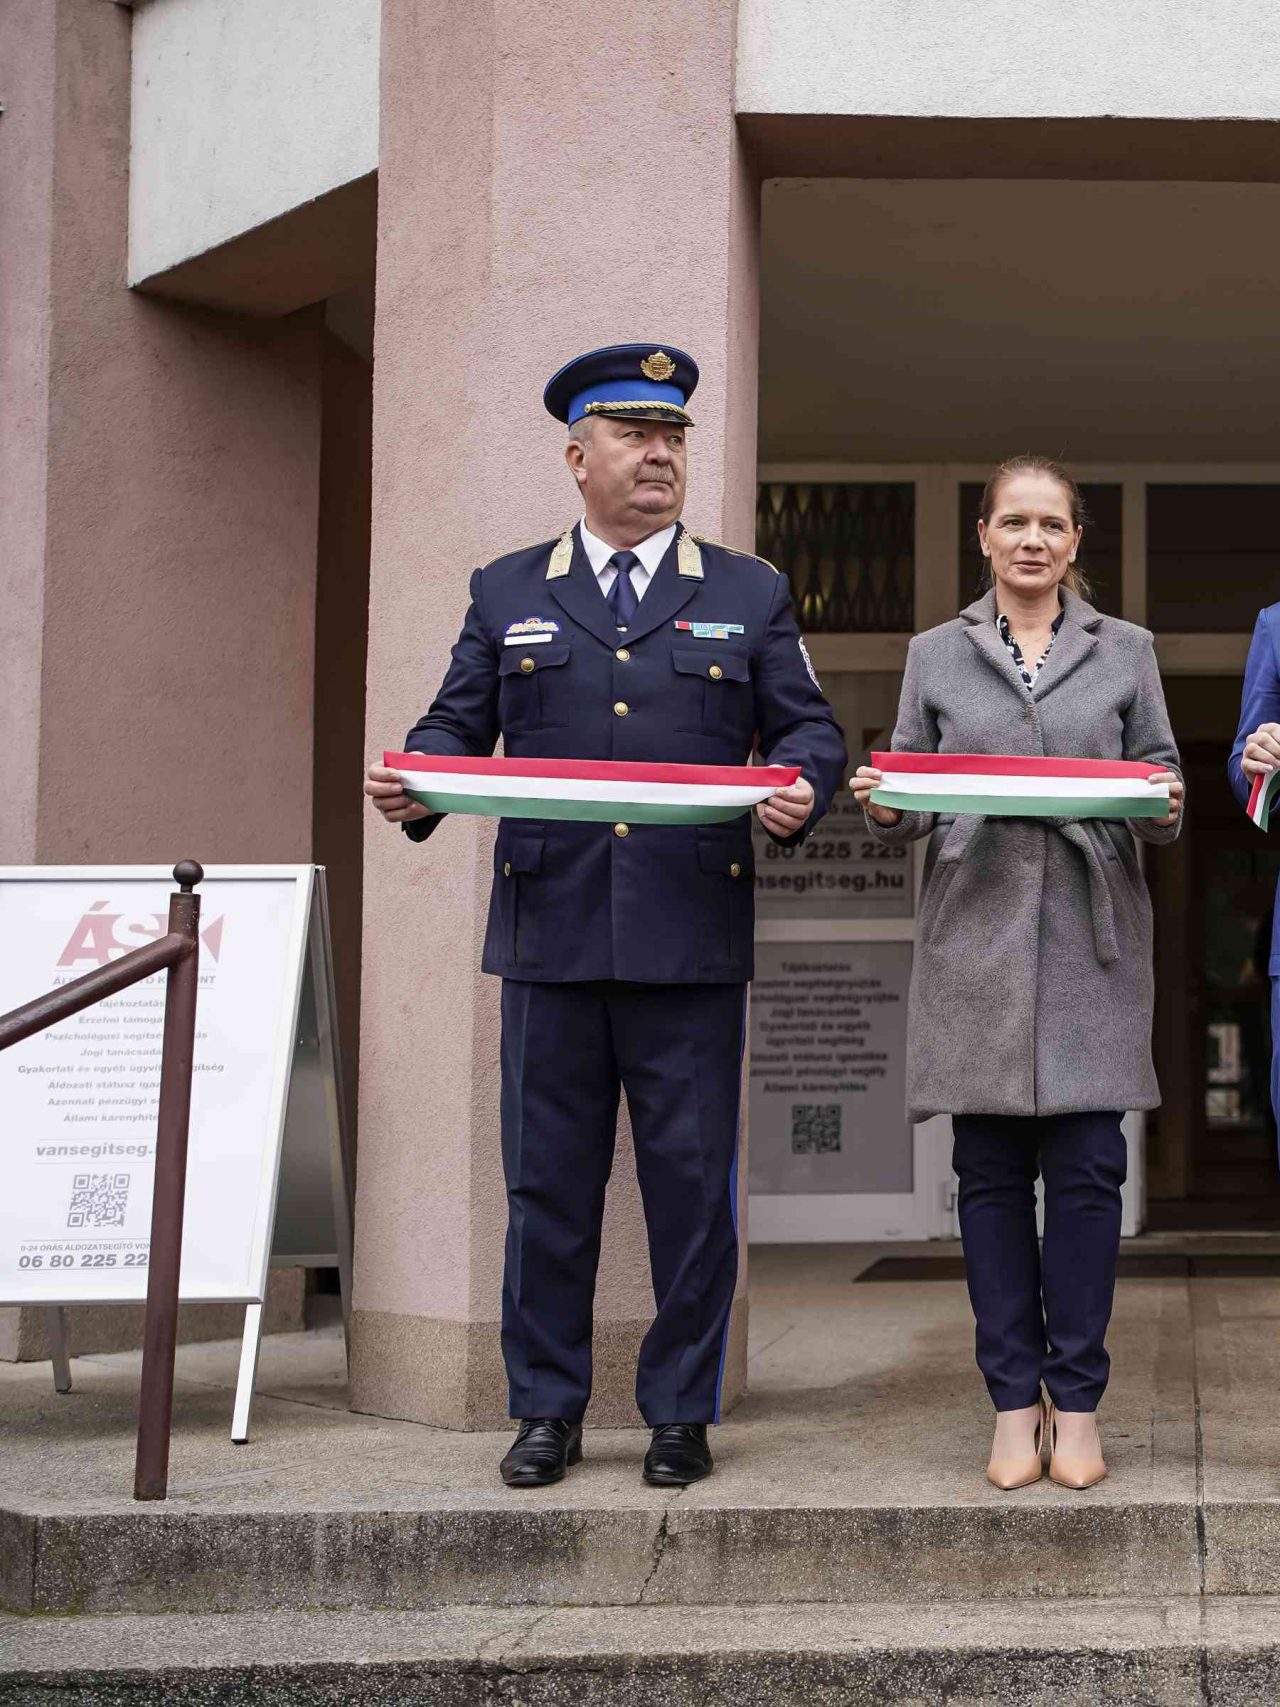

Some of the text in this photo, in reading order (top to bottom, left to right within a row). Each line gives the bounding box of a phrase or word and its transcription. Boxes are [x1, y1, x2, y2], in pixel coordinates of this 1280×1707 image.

[804, 841, 851, 859] 225
[860, 841, 907, 859] 225
[755, 869, 904, 893] nsegitseg.hu
[106, 1048, 163, 1057] tanácsadá
[17, 1064, 75, 1075] Gyakorlati
[36, 1142, 153, 1159] vansegitseg.
[18, 1253, 149, 1268] 06 80 225 22
